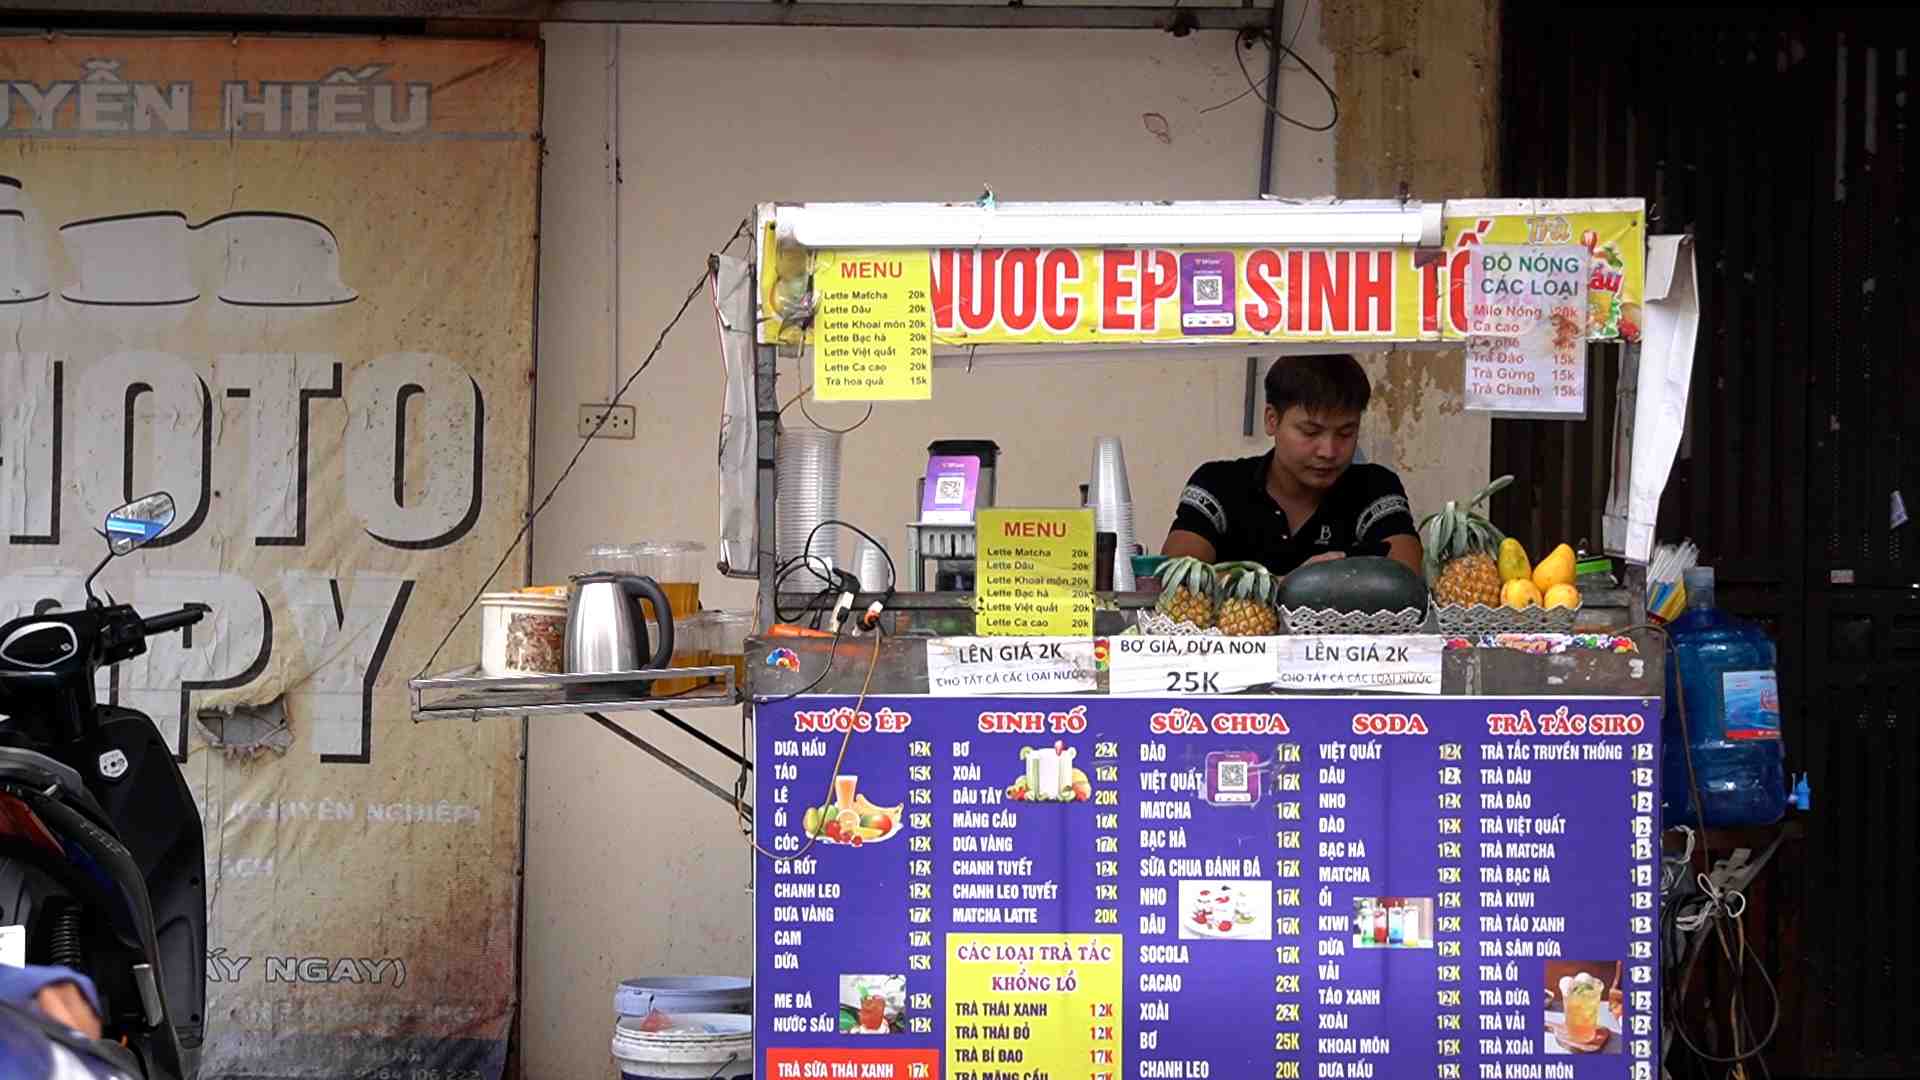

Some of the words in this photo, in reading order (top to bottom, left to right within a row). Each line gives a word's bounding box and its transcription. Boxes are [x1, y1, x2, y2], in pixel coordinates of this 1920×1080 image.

[0, 59, 190, 131] YỄN
[224, 64, 430, 133] HIẾU
[841, 261, 903, 279] MENU
[1244, 249, 1392, 332] SINH
[1481, 275, 1523, 295] CÁC
[1531, 279, 1579, 301] LOẠI
[1004, 521, 1066, 538] MENU
[959, 644, 993, 664] LÊN
[1000, 641, 1033, 661] GIÁ
[1039, 643, 1063, 659] 2K
[1229, 641, 1266, 655] NON
[1305, 642, 1339, 662] LÊN
[1346, 643, 1379, 662] GIÁ
[1385, 646, 1409, 662] 2K
[1166, 671, 1220, 693] 25K
[796, 708, 871, 731] NƯỚC
[980, 713, 1044, 732] SINH
[1049, 706, 1087, 732] TỐ
[1152, 708, 1207, 733] SỮA
[1212, 713, 1289, 733] CHUA
[1353, 713, 1428, 734] SODA
[1488, 710, 1536, 734] TRÀ
[1540, 707, 1586, 734] TẮC
[1589, 714, 1643, 734] SIRO
[774, 740, 799, 757] DƯA
[801, 736, 826, 757] HẤU
[952, 740, 970, 757] BƠ
[1140, 740, 1167, 762] ĐÀO
[774, 762, 797, 780] TÁO
[952, 762, 981, 781] XOÀI
[1319, 765, 1346, 785] DÂU
[952, 786, 978, 805] DÂU
[979, 786, 1003, 805] TÂY
[1095, 791, 1118, 806] 20K
[1319, 792, 1346, 809] NHO
[1480, 791, 1504, 809] TRÀ
[1506, 791, 1531, 810] ĐÀO
[1140, 800, 1192, 820] MATCHA
[1318, 814, 1345, 833] ĐÀO
[774, 832, 799, 851] CÓC
[1140, 829, 1166, 852] BẠC
[1168, 826, 1187, 848] HÀ
[1479, 839, 1504, 858] TRÀ
[1506, 843, 1556, 859] MATCHA
[952, 860, 994, 876] CHANH
[996, 856, 1033, 876] TUYẾT
[1318, 866, 1371, 883] MATCHA
[774, 883, 816, 898] CHANH
[818, 883, 841, 899] LEO
[1139, 887, 1167, 906] NHO
[1479, 889, 1503, 908] TRÀ
[1505, 892, 1535, 908] KIWI
[774, 905, 799, 922] DƯA
[801, 904, 834, 922] VÀNG
[952, 907, 1002, 923] MATCHA
[1004, 907, 1038, 924] LATTE
[1095, 909, 1118, 924] 20K
[1479, 913, 1503, 932] TRÀ
[1505, 913, 1529, 933] TÁO
[1531, 916, 1565, 933] XANH
[1139, 912, 1166, 935] DÂU
[1318, 915, 1349, 932] KIWI
[774, 930, 802, 946] CAM
[958, 942, 991, 961] CÁC
[996, 946, 1034, 965] LOẠI
[1040, 942, 1072, 961] TRÀ
[1139, 944, 1189, 964] SOCOLA
[265, 957, 406, 988] NGAY)
[1139, 973, 1182, 993] CACAO
[1318, 986, 1343, 1005] TÁO
[1345, 989, 1381, 1005] XANH
[955, 1000, 978, 1016] TRÀ
[1013, 1002, 1047, 1016] XANH
[1139, 999, 1169, 1021] XOÀI
[1318, 1010, 1348, 1029] XOÀI
[955, 1024, 978, 1040] TRÀ
[1139, 1030, 1158, 1050] BƠ
[1276, 1033, 1300, 1050] 25K
[955, 1047, 978, 1063] TRÀ
[1318, 1038, 1357, 1054] KHOAI
[1359, 1036, 1390, 1054] MÔN
[778, 1061, 800, 1078] TRÀ
[804, 1061, 828, 1078] SỮA
[861, 1063, 893, 1078] XANH
[1139, 1060, 1183, 1078] CHANH
[1186, 1060, 1209, 1079] LEO
[1276, 1062, 1300, 1079] 20K
